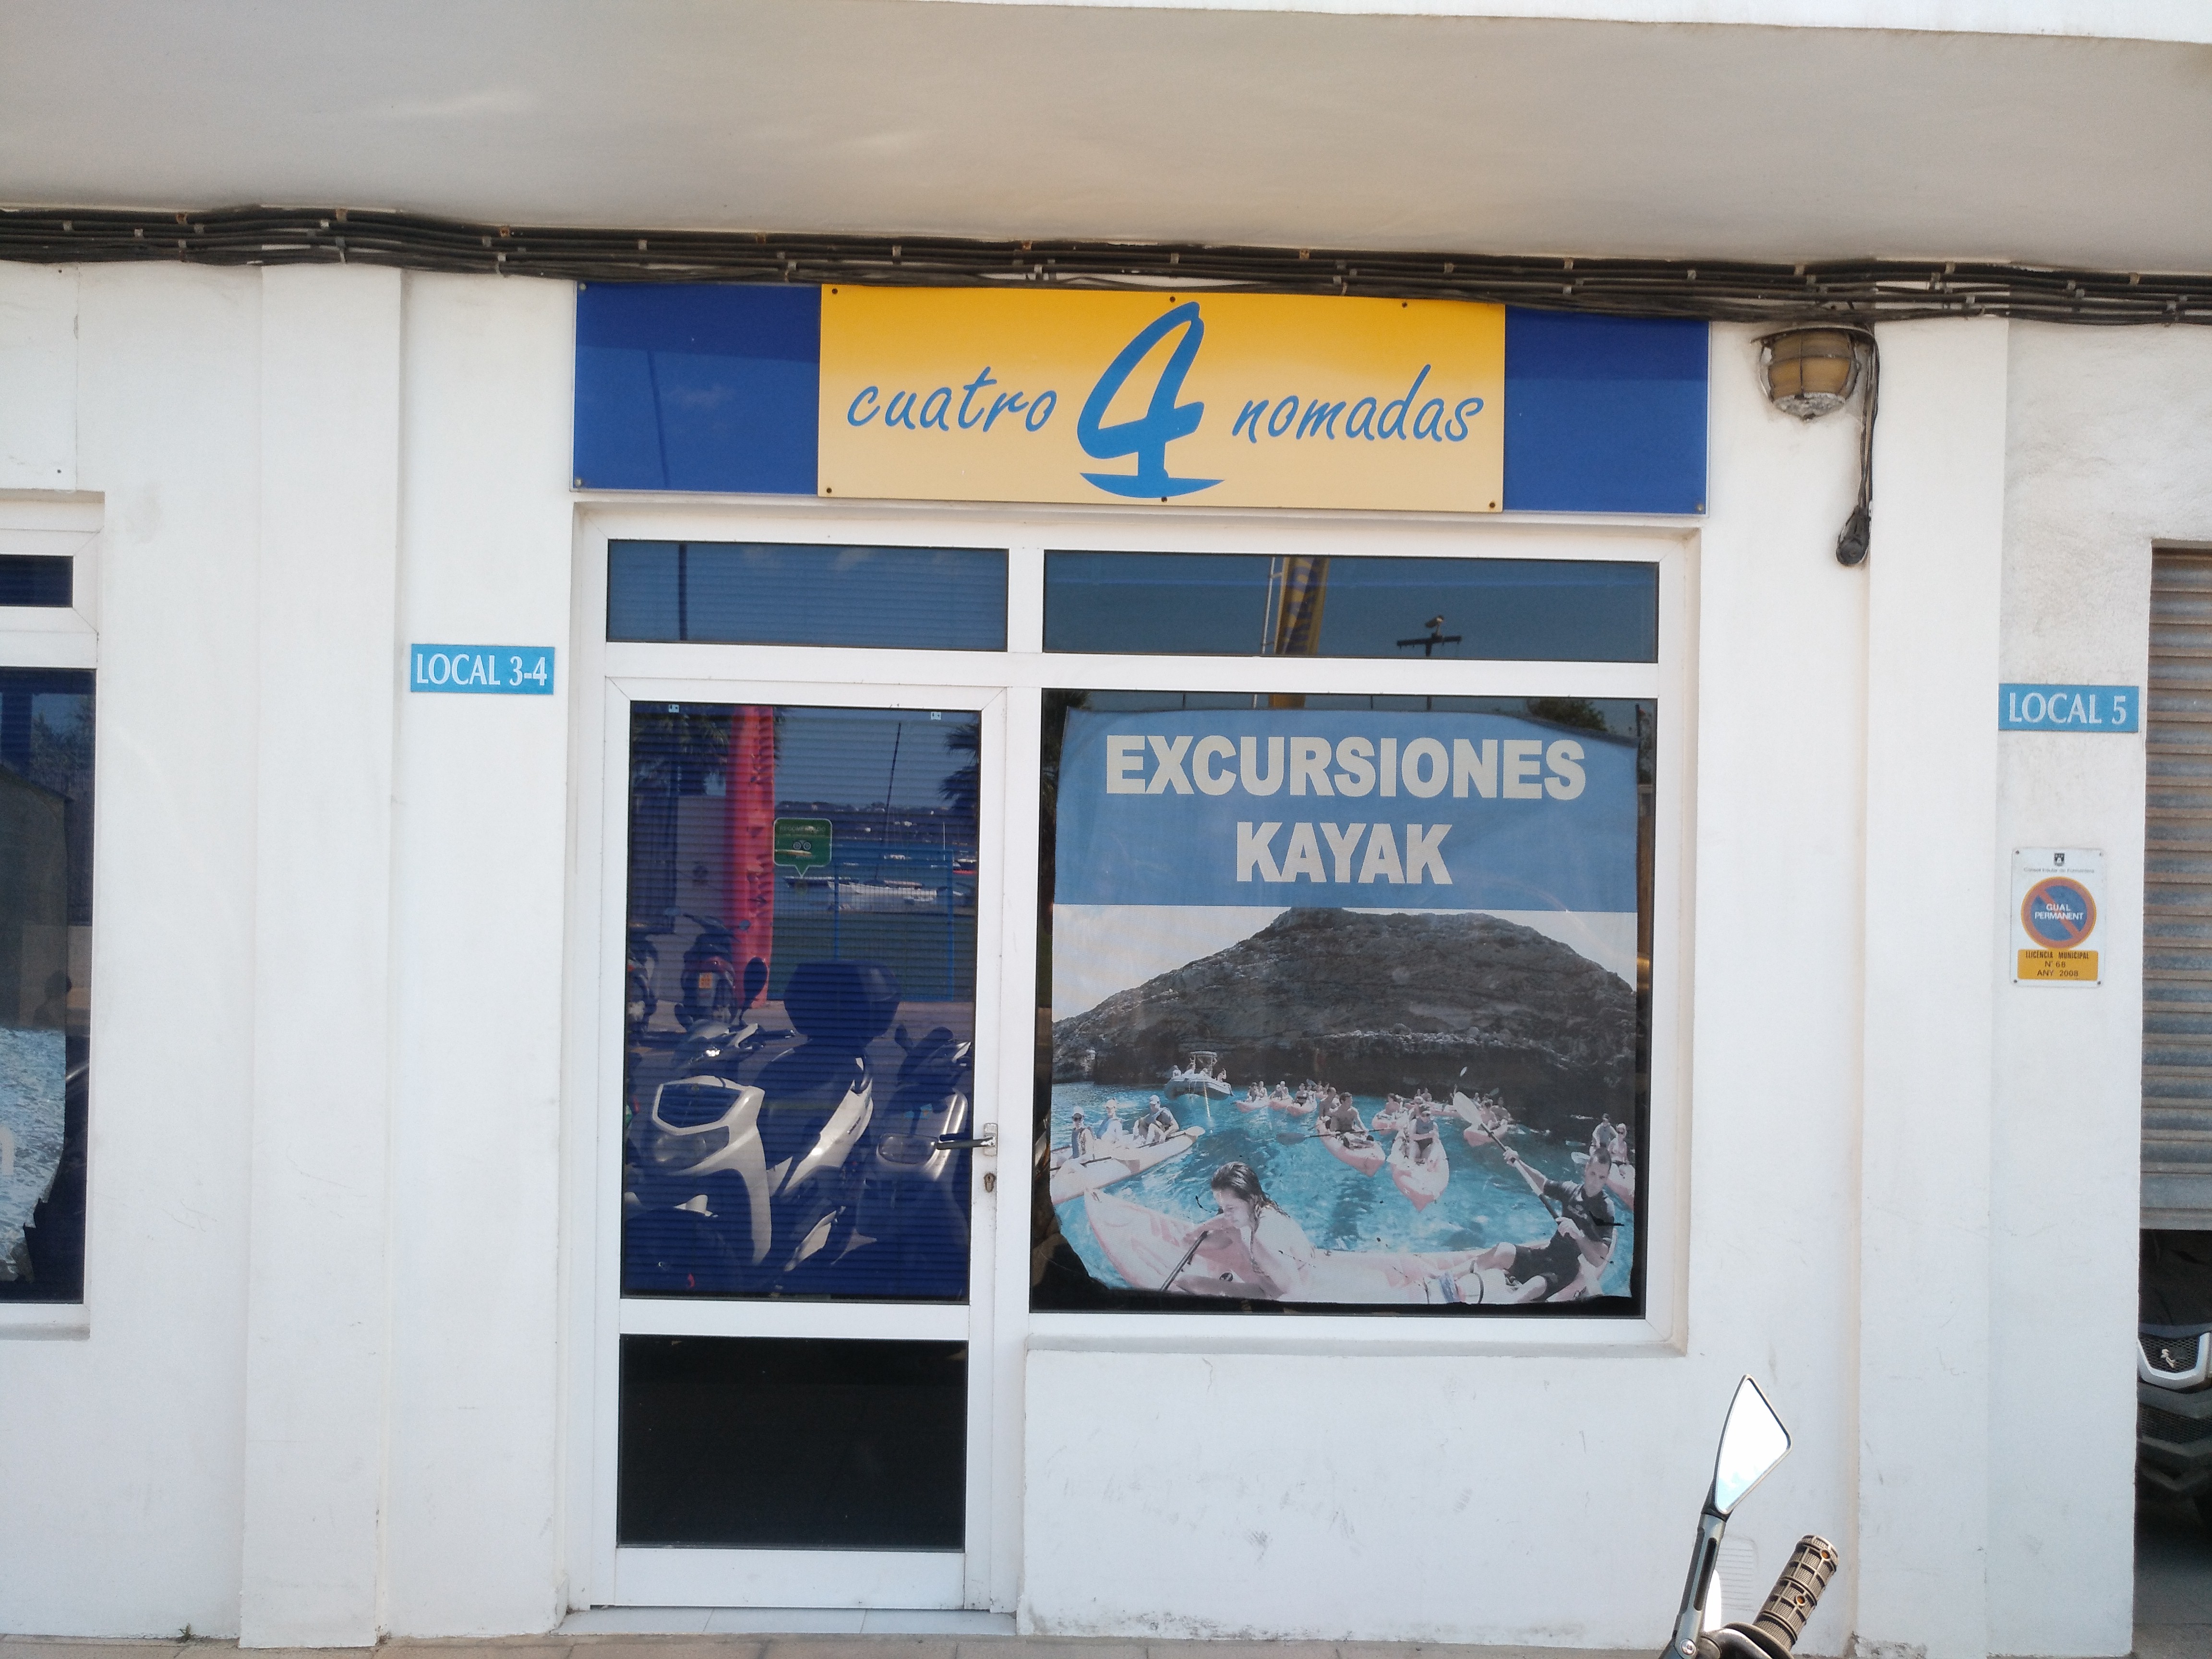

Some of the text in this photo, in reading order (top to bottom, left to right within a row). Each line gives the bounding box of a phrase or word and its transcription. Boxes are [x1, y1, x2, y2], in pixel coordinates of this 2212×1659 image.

[847, 301, 1484, 498] cuatro 4 nomadas
[417, 653, 547, 686] LOCAL 3-4
[2009, 692, 2127, 724] LOCAL 5
[1106, 734, 1586, 801] EXCURSIONES
[1236, 821, 1453, 885] KAYAK
[2034, 911, 2084, 920] PERMANENT
[2046, 903, 2071, 912] GUAL
